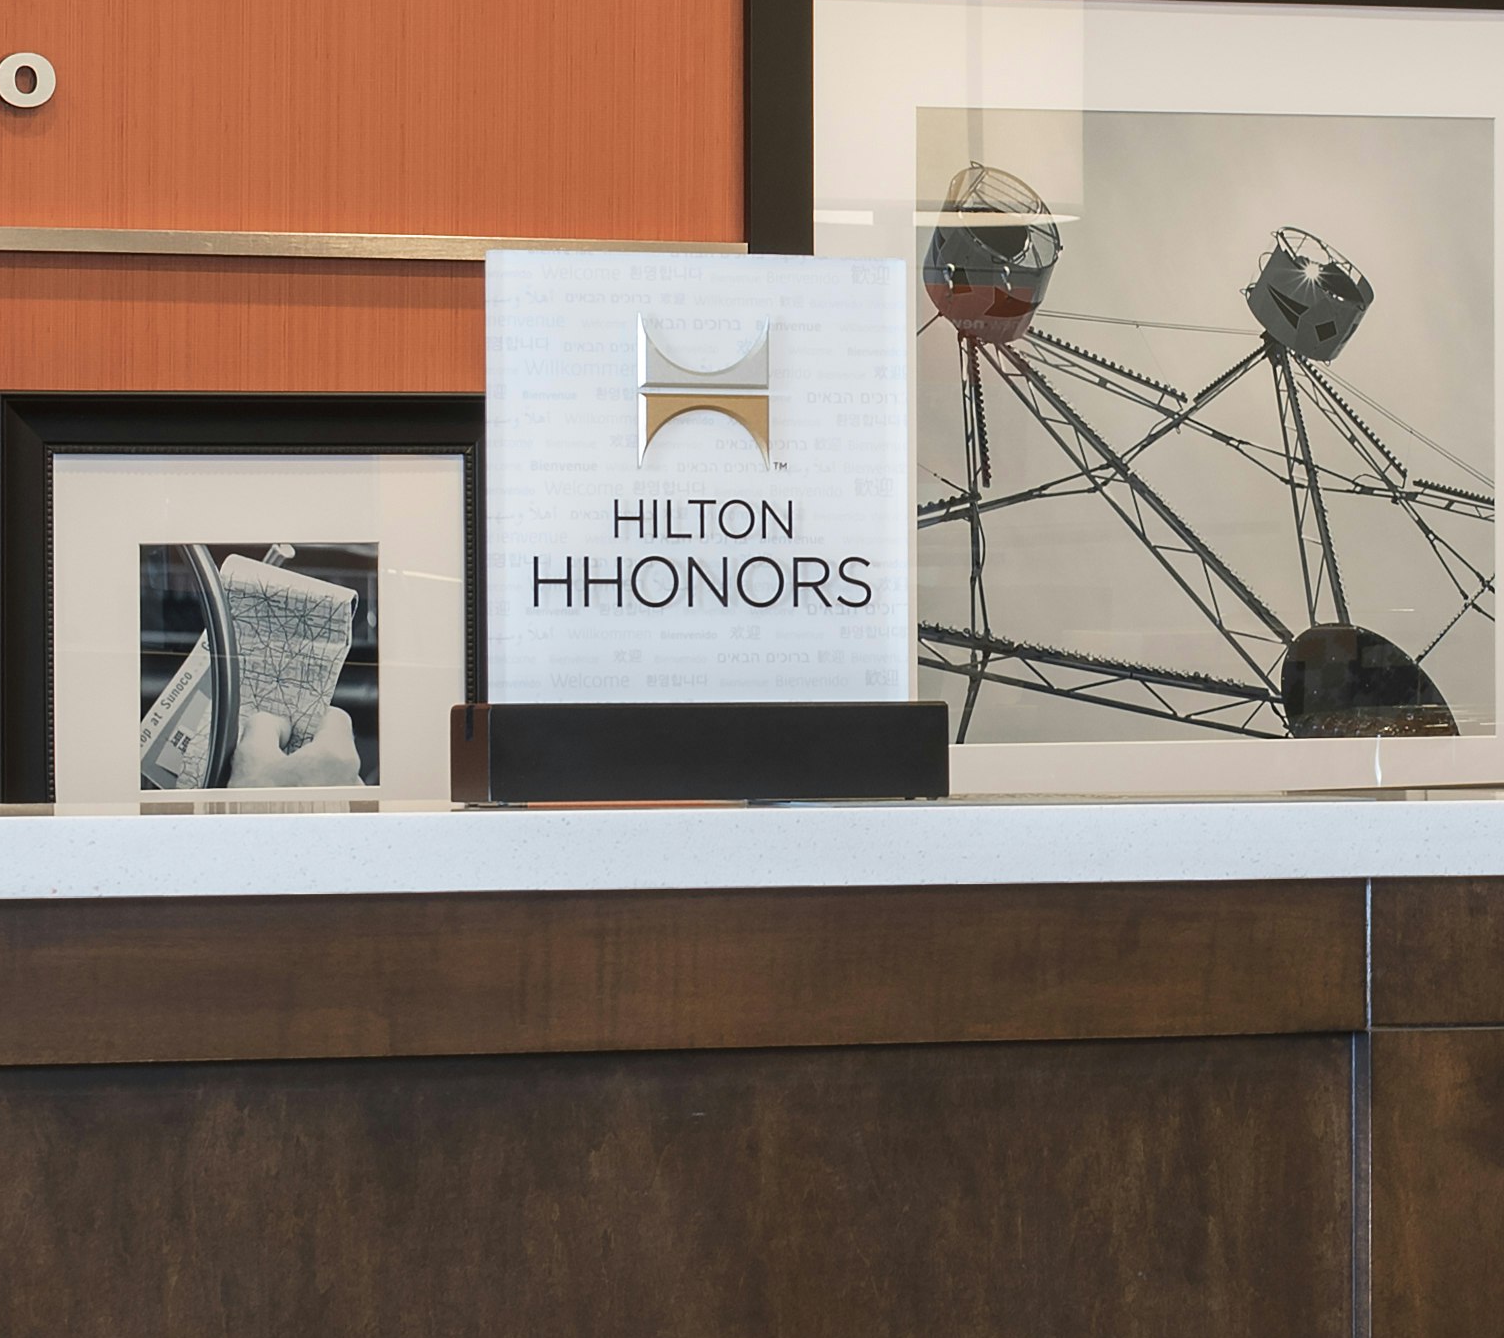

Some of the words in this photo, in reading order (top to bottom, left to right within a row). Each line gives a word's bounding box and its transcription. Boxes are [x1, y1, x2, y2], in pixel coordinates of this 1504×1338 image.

[541, 265, 621, 282] Welcome
[544, 478, 625, 496] Welcome
[613, 499, 793, 539] HILTON
[532, 555, 873, 608] HHONORS
[550, 672, 630, 689] Welcome
[151, 712, 163, 726] at
[160, 671, 193, 710] Sunoco
